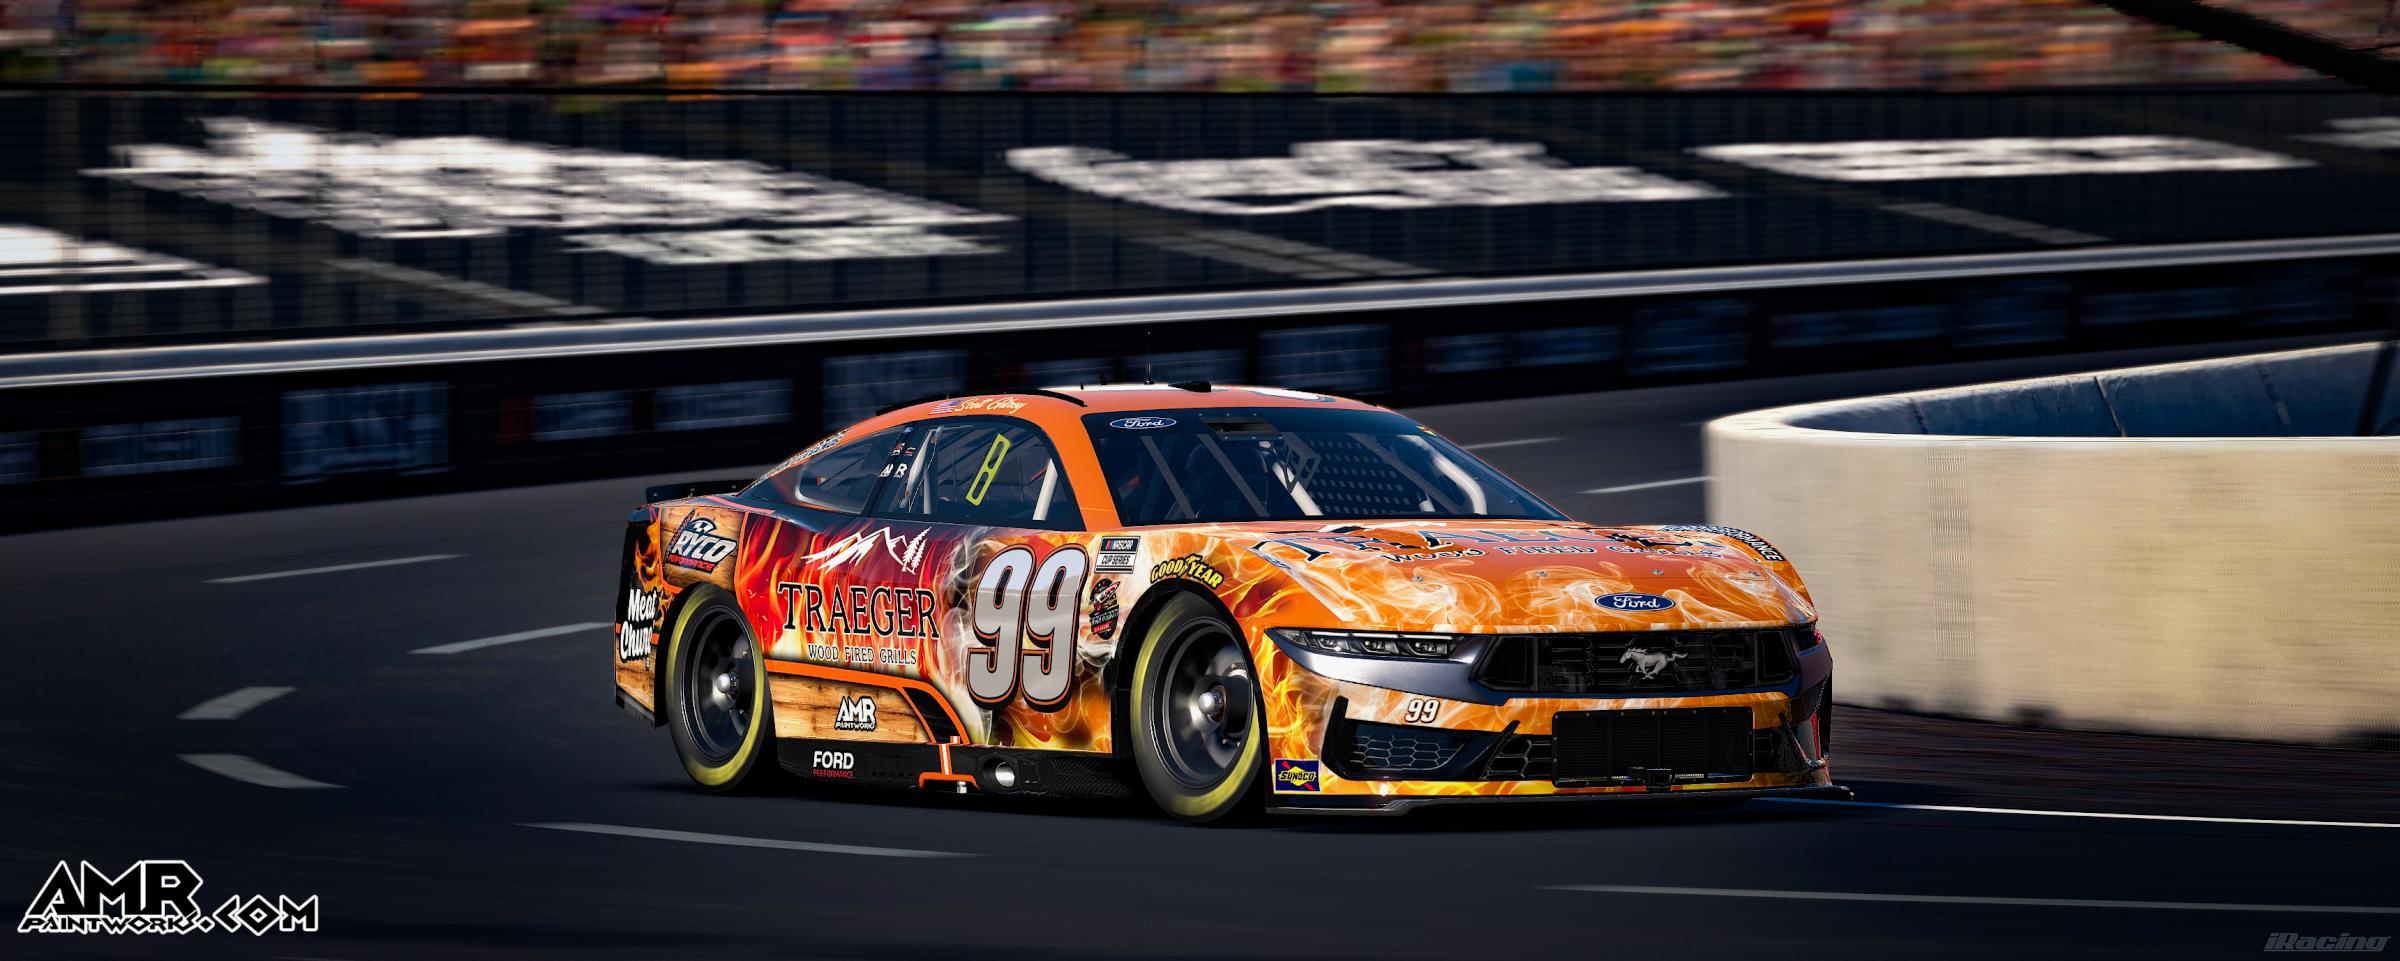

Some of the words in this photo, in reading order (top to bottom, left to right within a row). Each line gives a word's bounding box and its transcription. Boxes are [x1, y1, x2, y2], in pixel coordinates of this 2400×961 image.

[671, 530, 737, 563] RYCO
[1495, 546, 1598, 555] FIRED
[1101, 555, 1113, 565] CUP
[1112, 555, 1131, 565] SERIES
[1151, 554, 1224, 589] GOODYEAR
[628, 588, 657, 622] Meat
[778, 582, 939, 639] TRAEGER
[1613, 595, 1661, 609] Ford
[966, 543, 1090, 713] 99
[808, 644, 839, 660] WOOD
[845, 646, 874, 662] FIRED
[879, 649, 917, 665] GRILLS
[836, 697, 877, 722] AMR
[1404, 698, 1440, 723] 99
[812, 751, 854, 770] FORD
[812, 769, 855, 778] PERFORMANCE
[1278, 771, 1317, 782] SUNOCO
